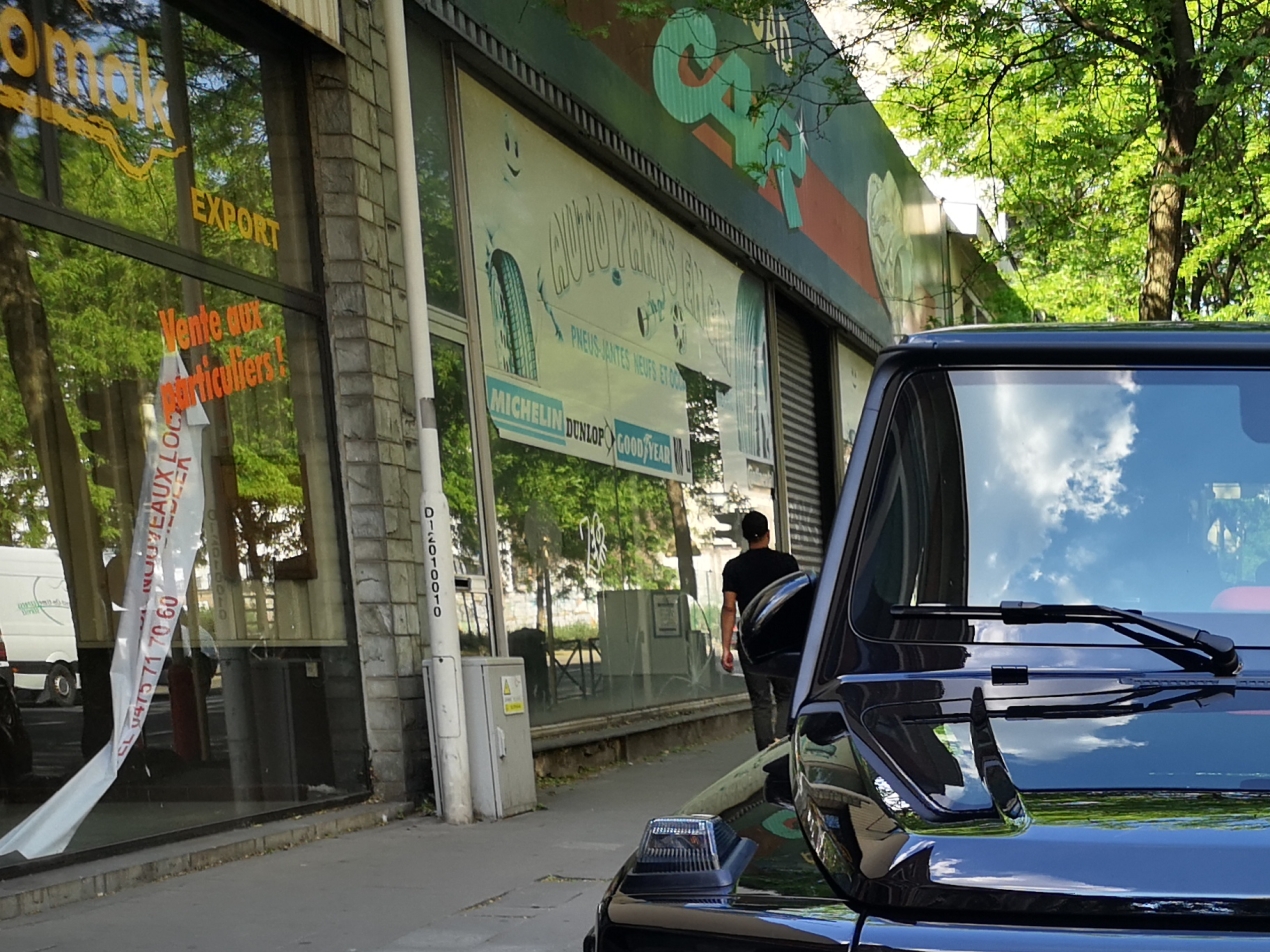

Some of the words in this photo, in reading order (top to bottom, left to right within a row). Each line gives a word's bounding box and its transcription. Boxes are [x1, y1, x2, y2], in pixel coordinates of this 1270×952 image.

[652, 7, 807, 229] CAR
[191, 187, 280, 251] EXPORT
[549, 193, 611, 296] AUTO
[612, 198, 678, 296] PARTS
[159, 304, 223, 353] Vente
[226, 300, 264, 337] aux
[160, 346, 274, 425] particuliers
[633, 353, 657, 382] NEUFS
[490, 387, 563, 432] MICHELIN
[565, 417, 605, 447] DUNLOP
[617, 433, 671, 466] GOODYEAR
[424, 506, 442, 618] D12010010
[156, 595, 179, 619] 60
[148, 624, 171, 647] 70
[141, 656, 161, 676] 71
